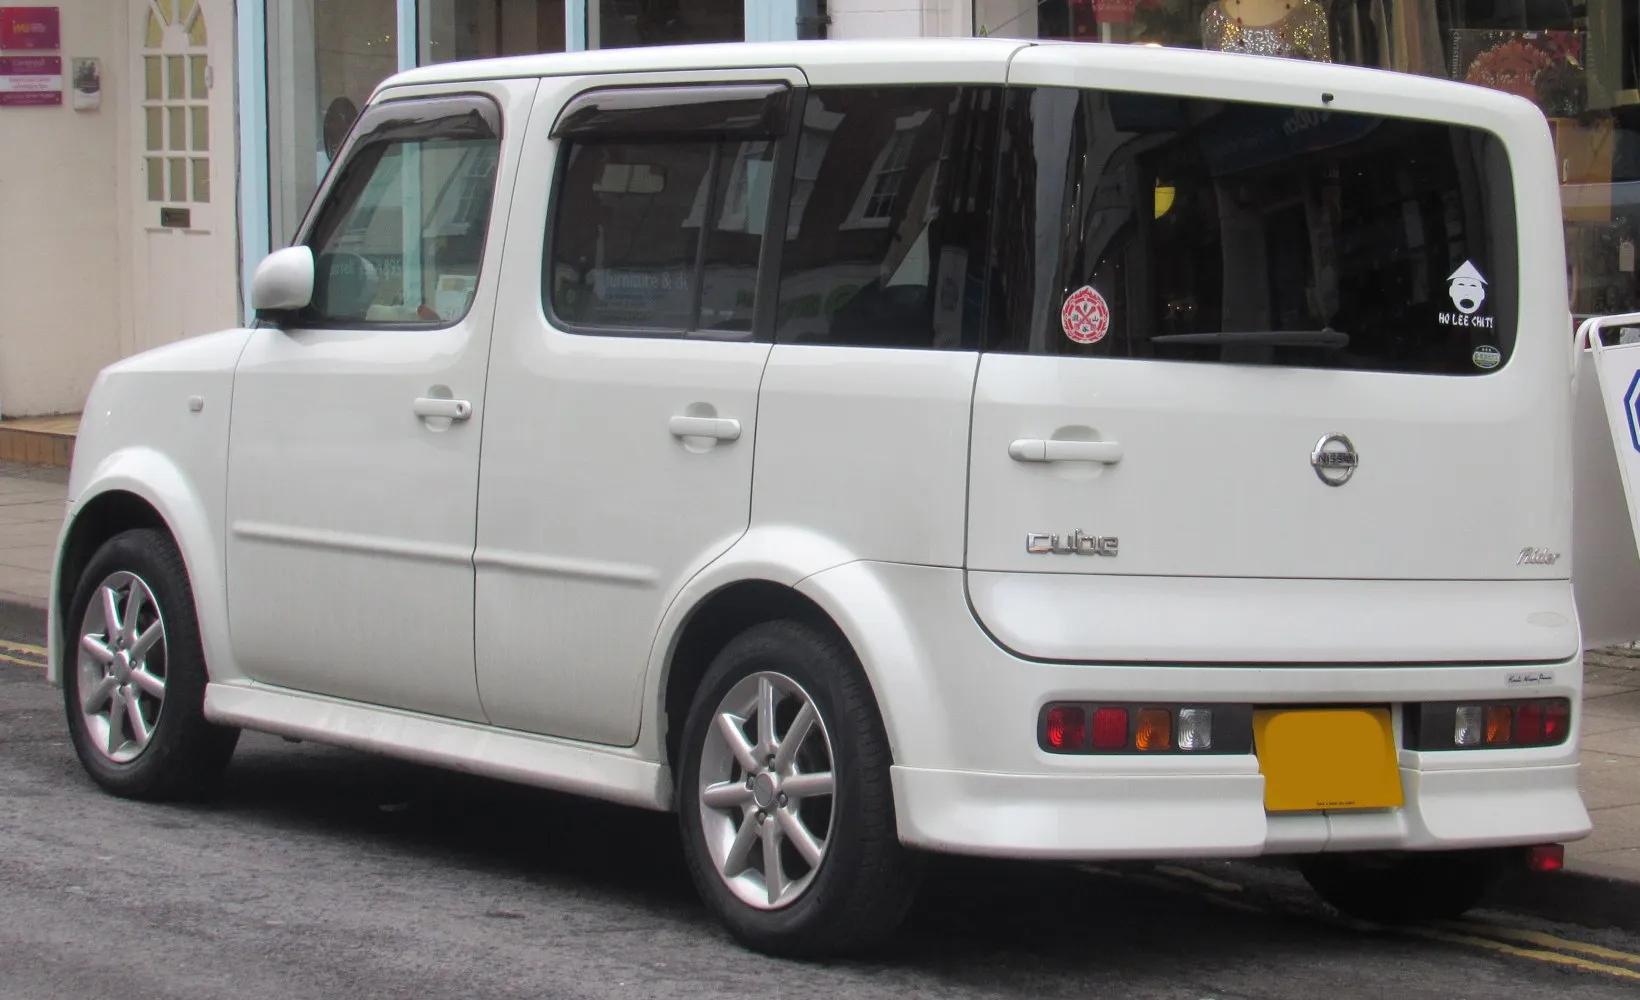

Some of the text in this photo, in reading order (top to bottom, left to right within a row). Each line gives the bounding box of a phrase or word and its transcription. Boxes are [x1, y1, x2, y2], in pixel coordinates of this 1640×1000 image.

[1438, 312, 1450, 324] HO
[1452, 314, 1469, 327] LEE
[1318, 452, 1358, 464] NISSAN
[1026, 528, 1119, 557] cube
